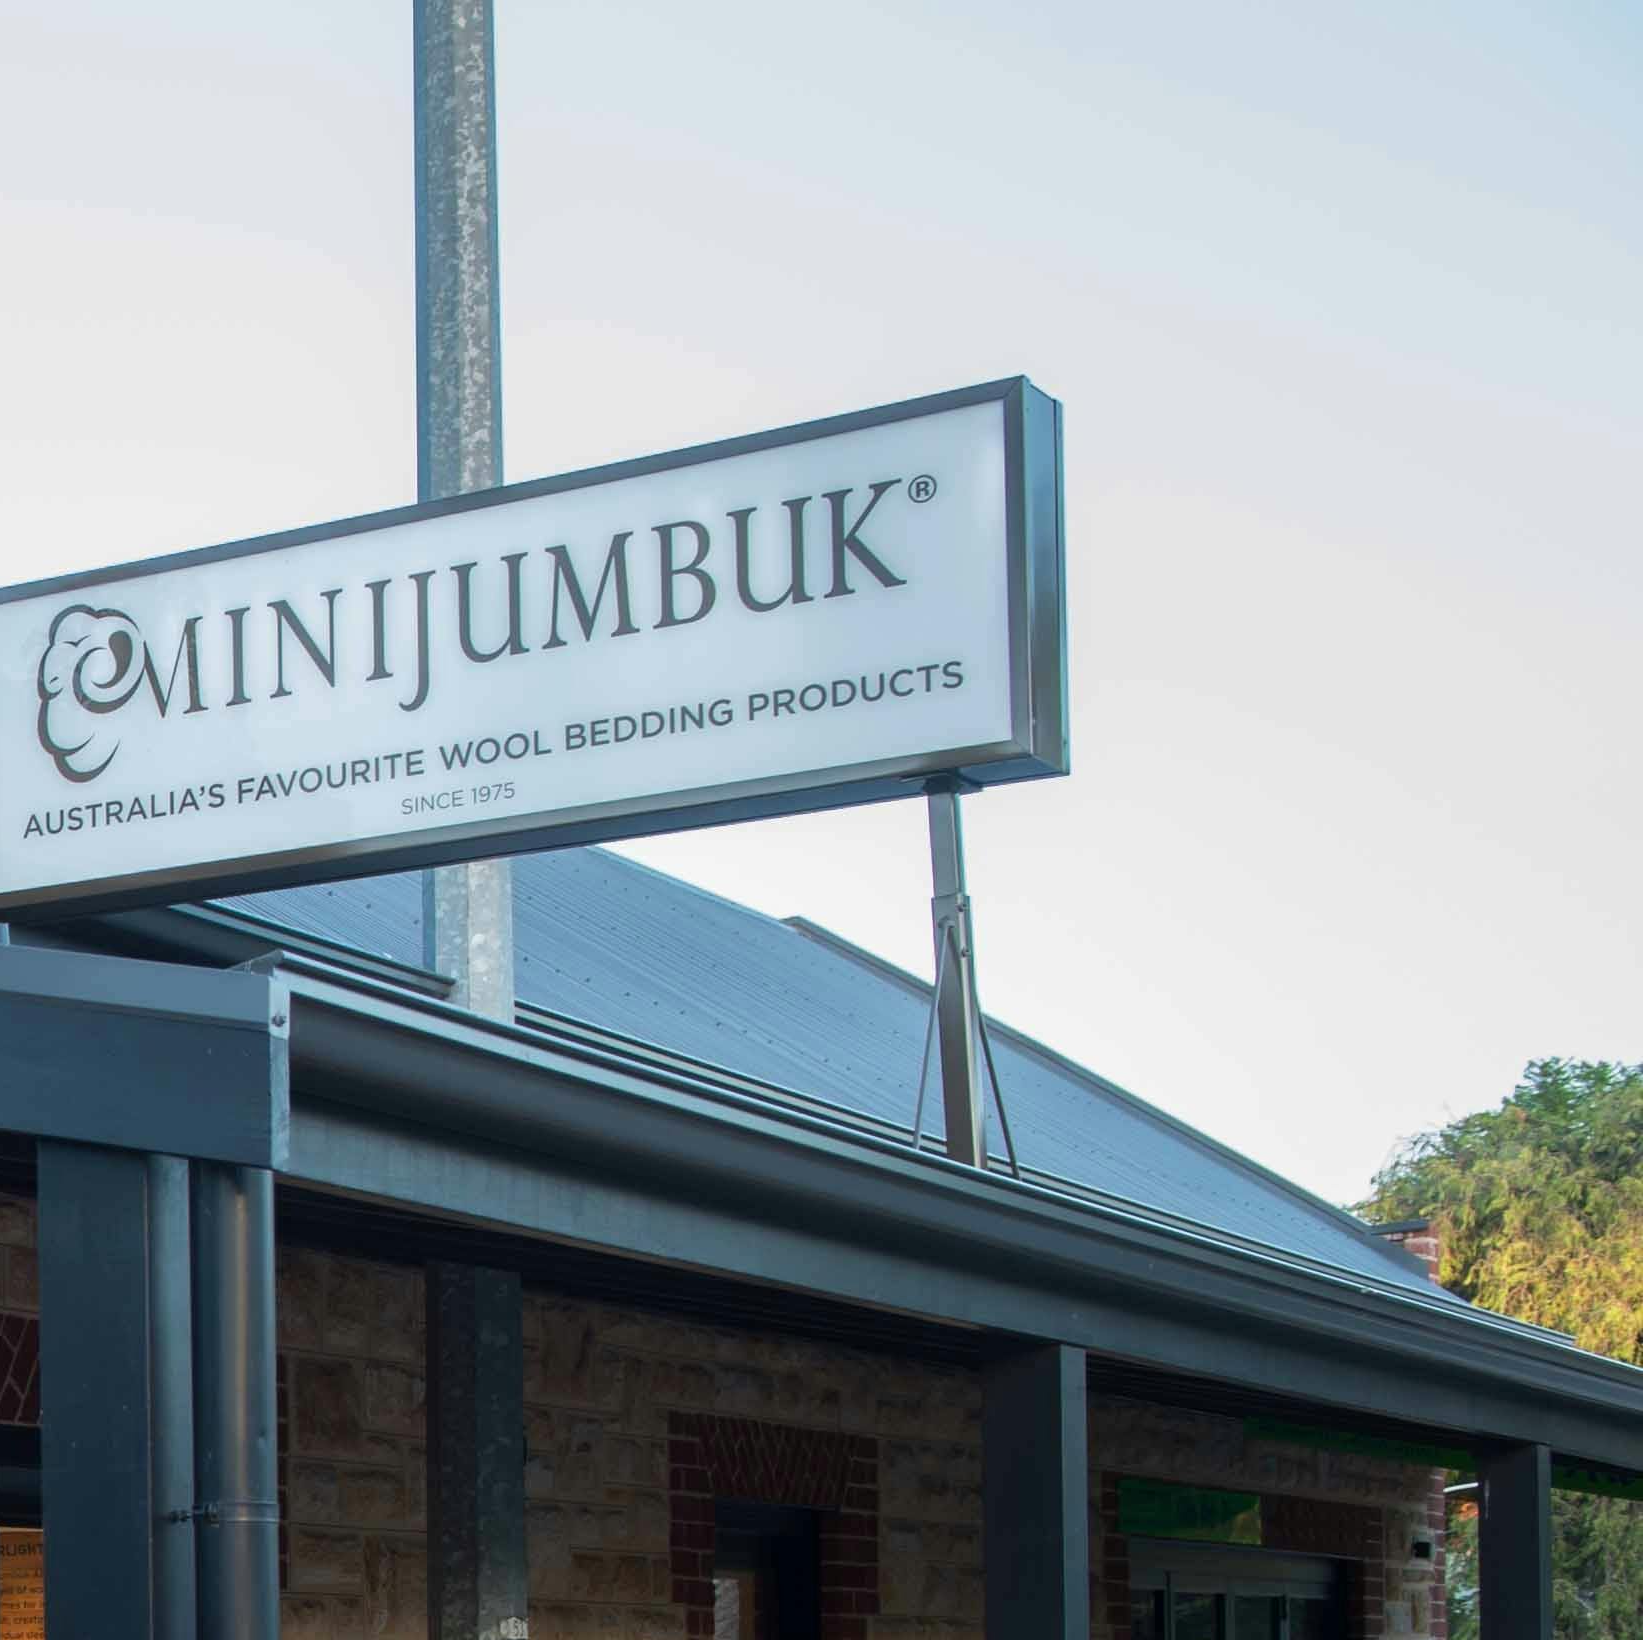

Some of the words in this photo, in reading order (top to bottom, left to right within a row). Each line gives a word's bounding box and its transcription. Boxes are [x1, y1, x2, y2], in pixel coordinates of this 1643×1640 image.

[237, 750, 425, 804] FAVOURITE
[439, 731, 552, 770] WOOL
[565, 700, 733, 750] BEDDING
[748, 661, 964, 720] PRODUCTS
[401, 789, 465, 815] SINCE
[471, 782, 516, 806] 1975
